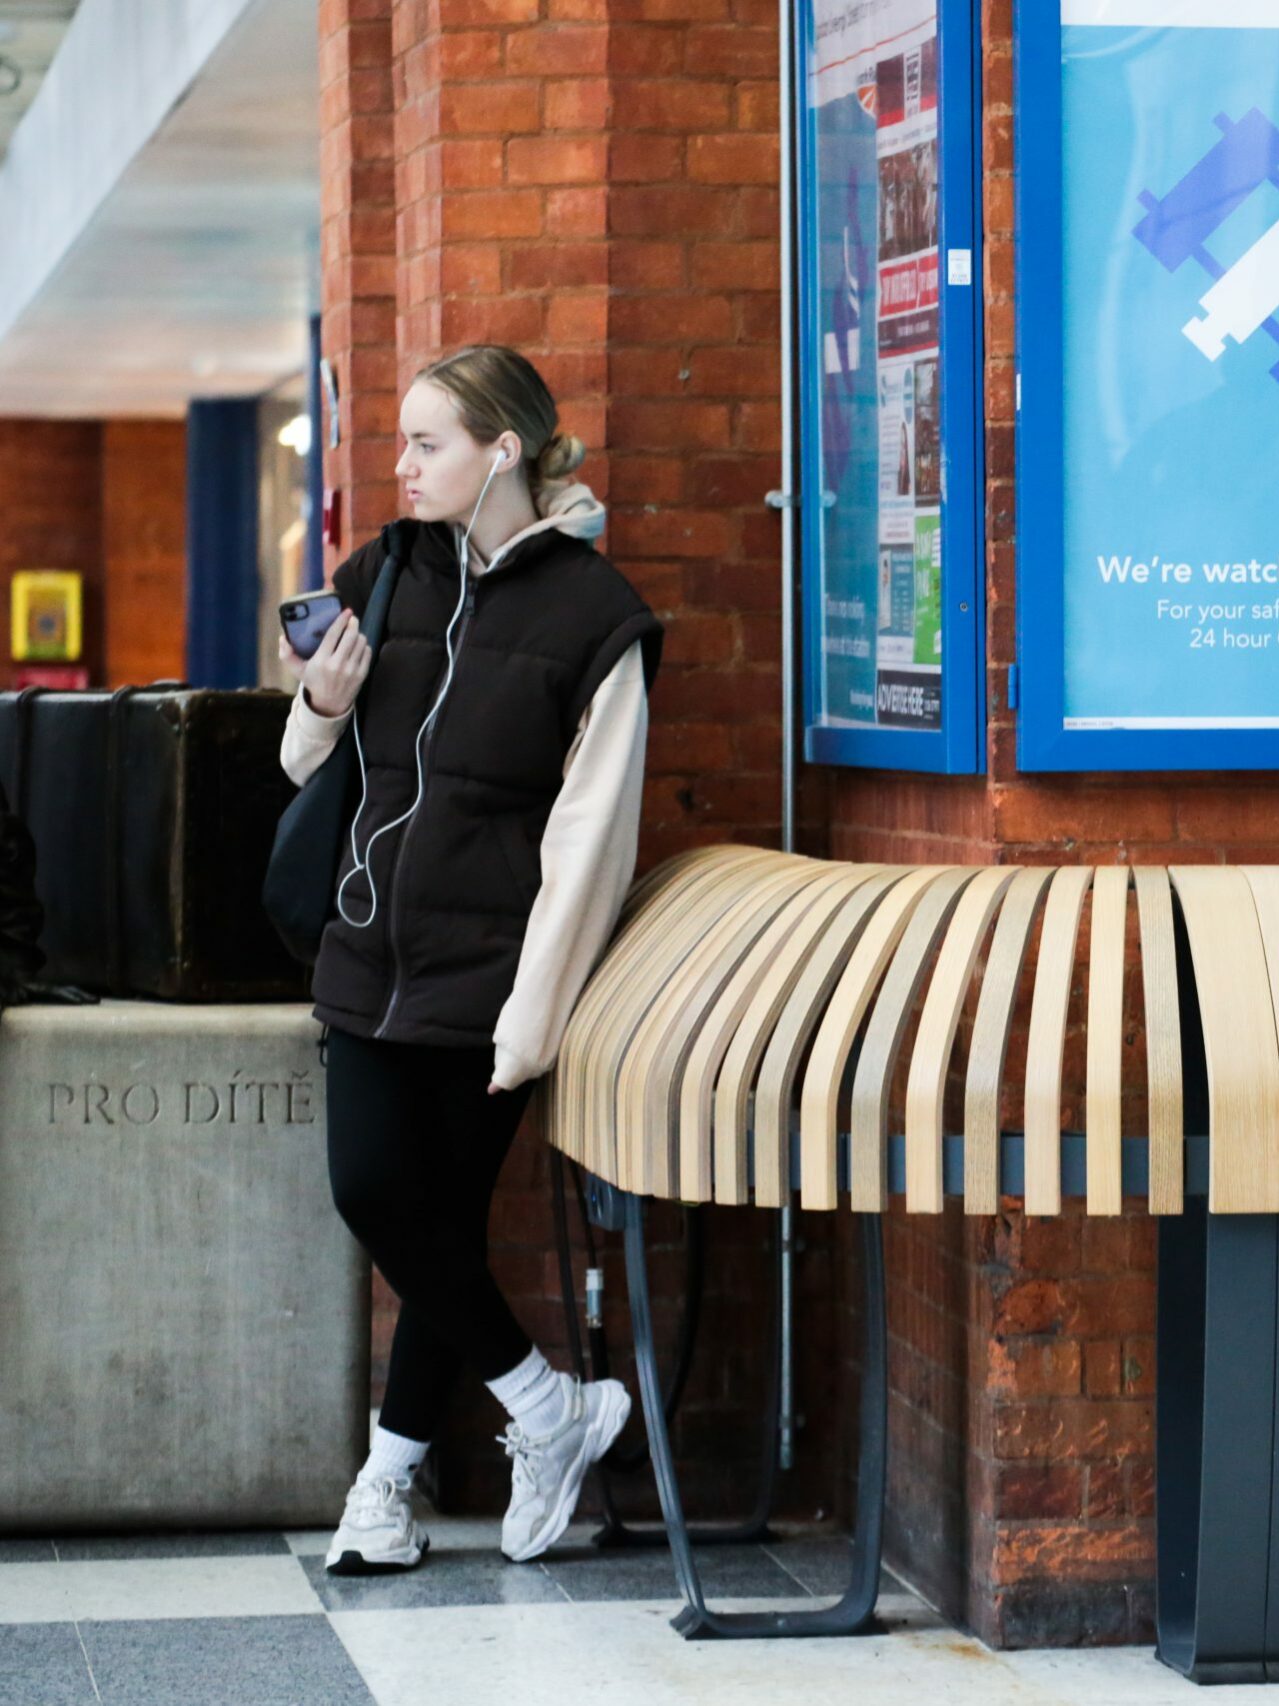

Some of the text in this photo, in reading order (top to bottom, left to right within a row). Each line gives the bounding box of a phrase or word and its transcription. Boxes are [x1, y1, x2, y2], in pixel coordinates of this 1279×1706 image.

[1098, 556, 1192, 584] We're
[1157, 600, 1192, 619] For
[1198, 605, 1245, 625] your
[1190, 628, 1216, 648] 24
[1223, 628, 1271, 648] hour
[48, 1081, 161, 1126] PRO
